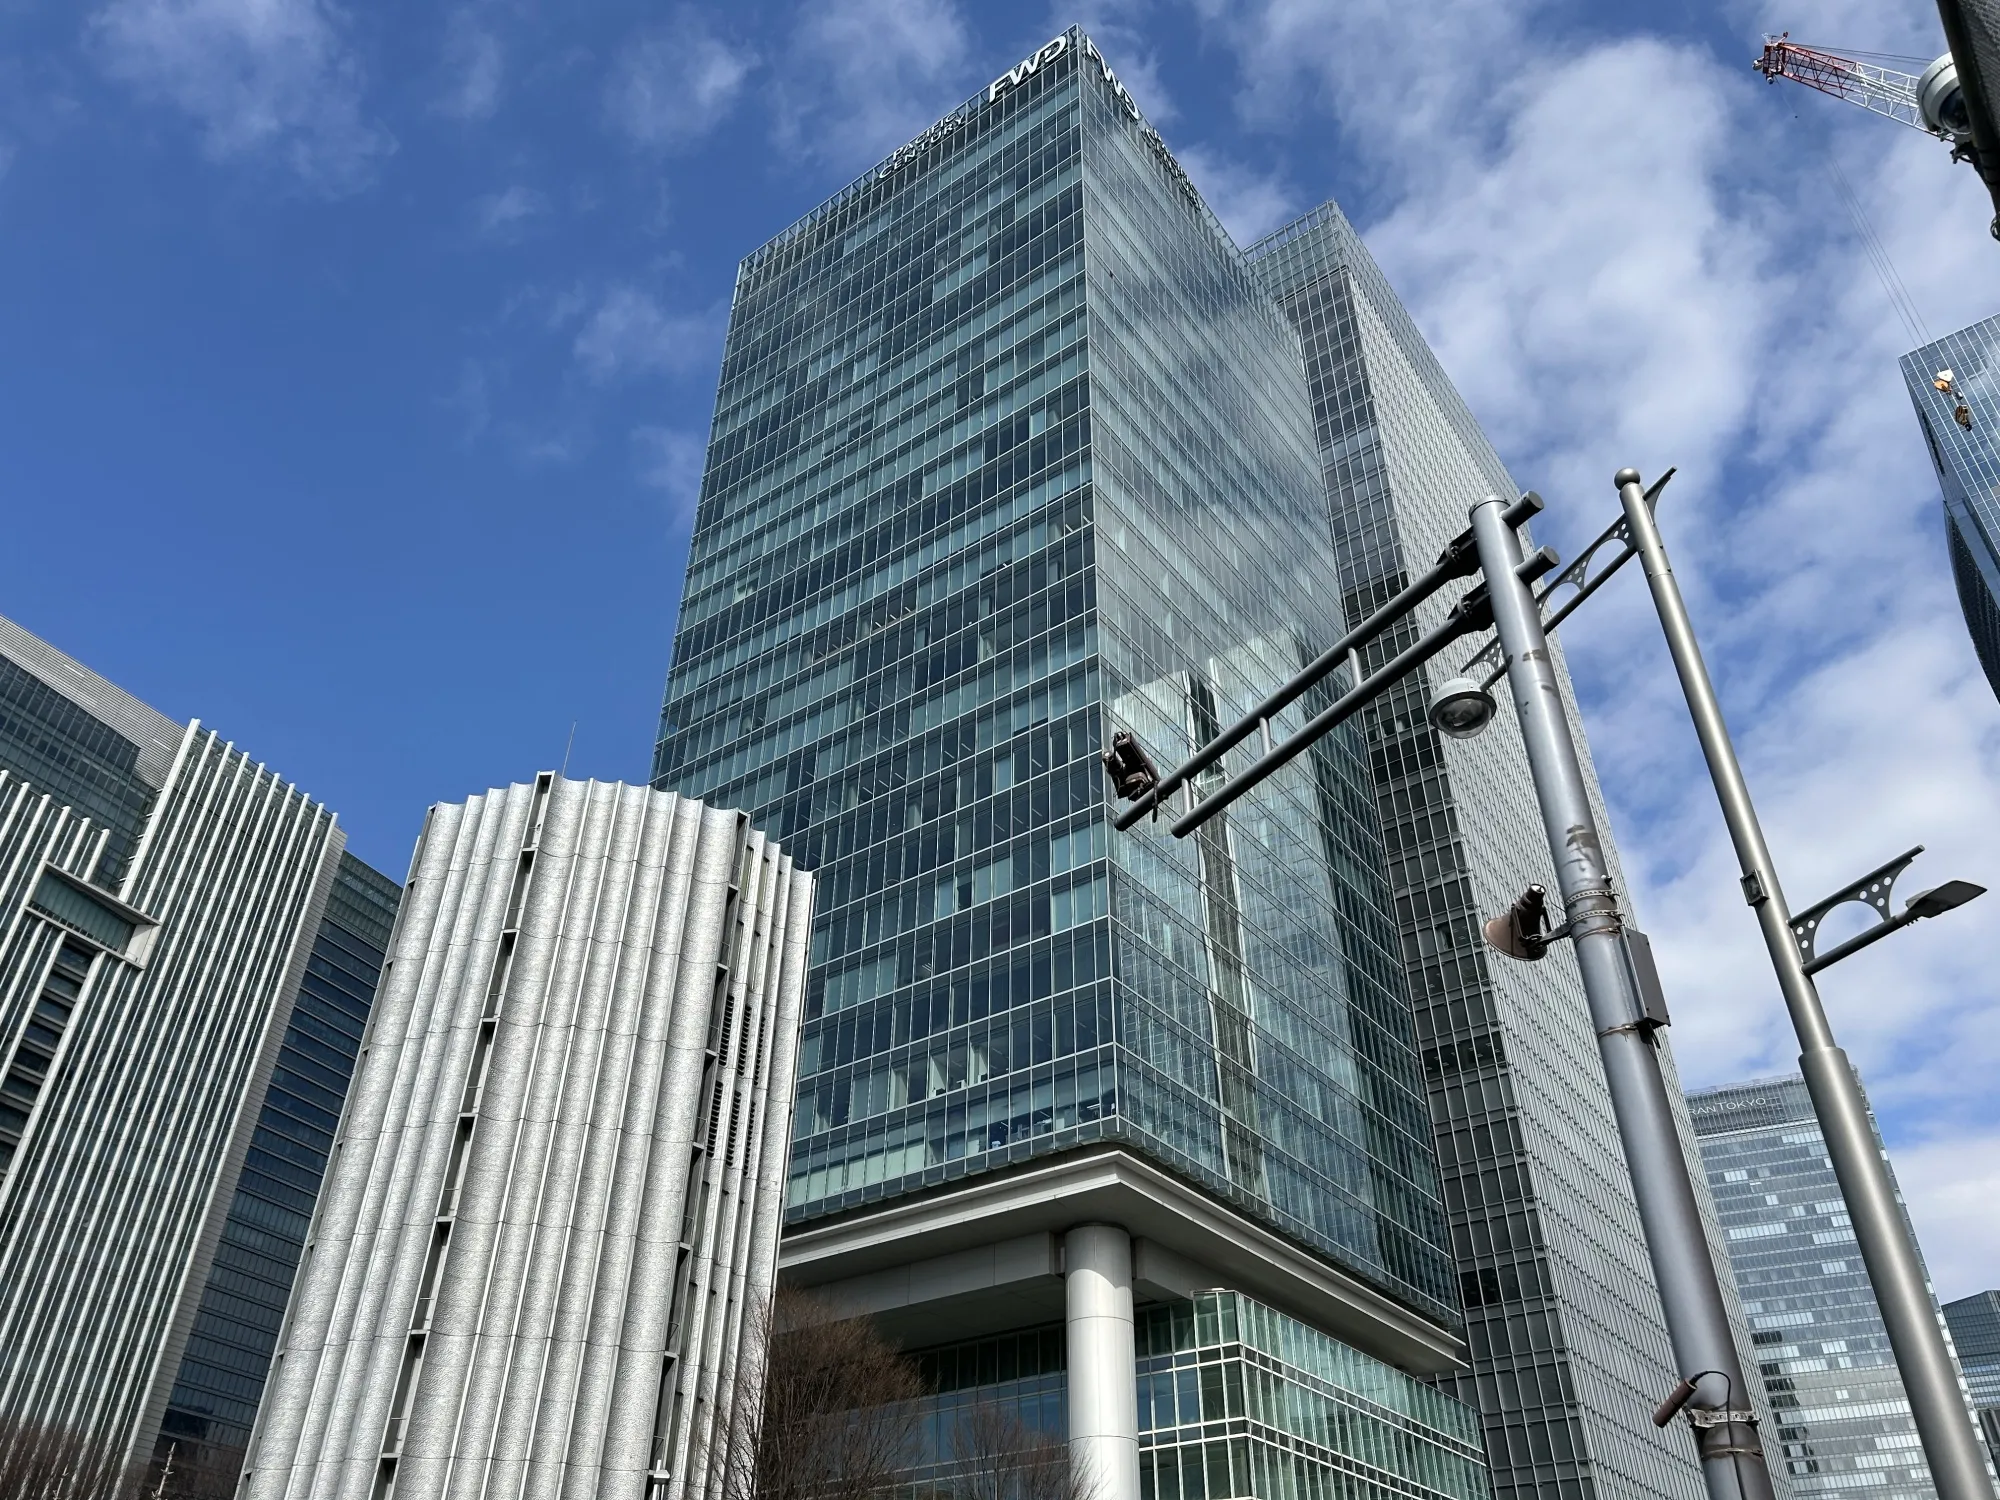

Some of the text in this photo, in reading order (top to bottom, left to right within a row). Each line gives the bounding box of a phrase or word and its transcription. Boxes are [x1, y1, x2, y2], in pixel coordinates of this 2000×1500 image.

[989, 36, 1067, 103] FWD
[1086, 35, 1140, 120] FWD
[879, 114, 966, 179] CENTURY
[893, 113, 957, 161] PACIFIC
[1687, 1097, 1766, 1116] RANTOKYO
